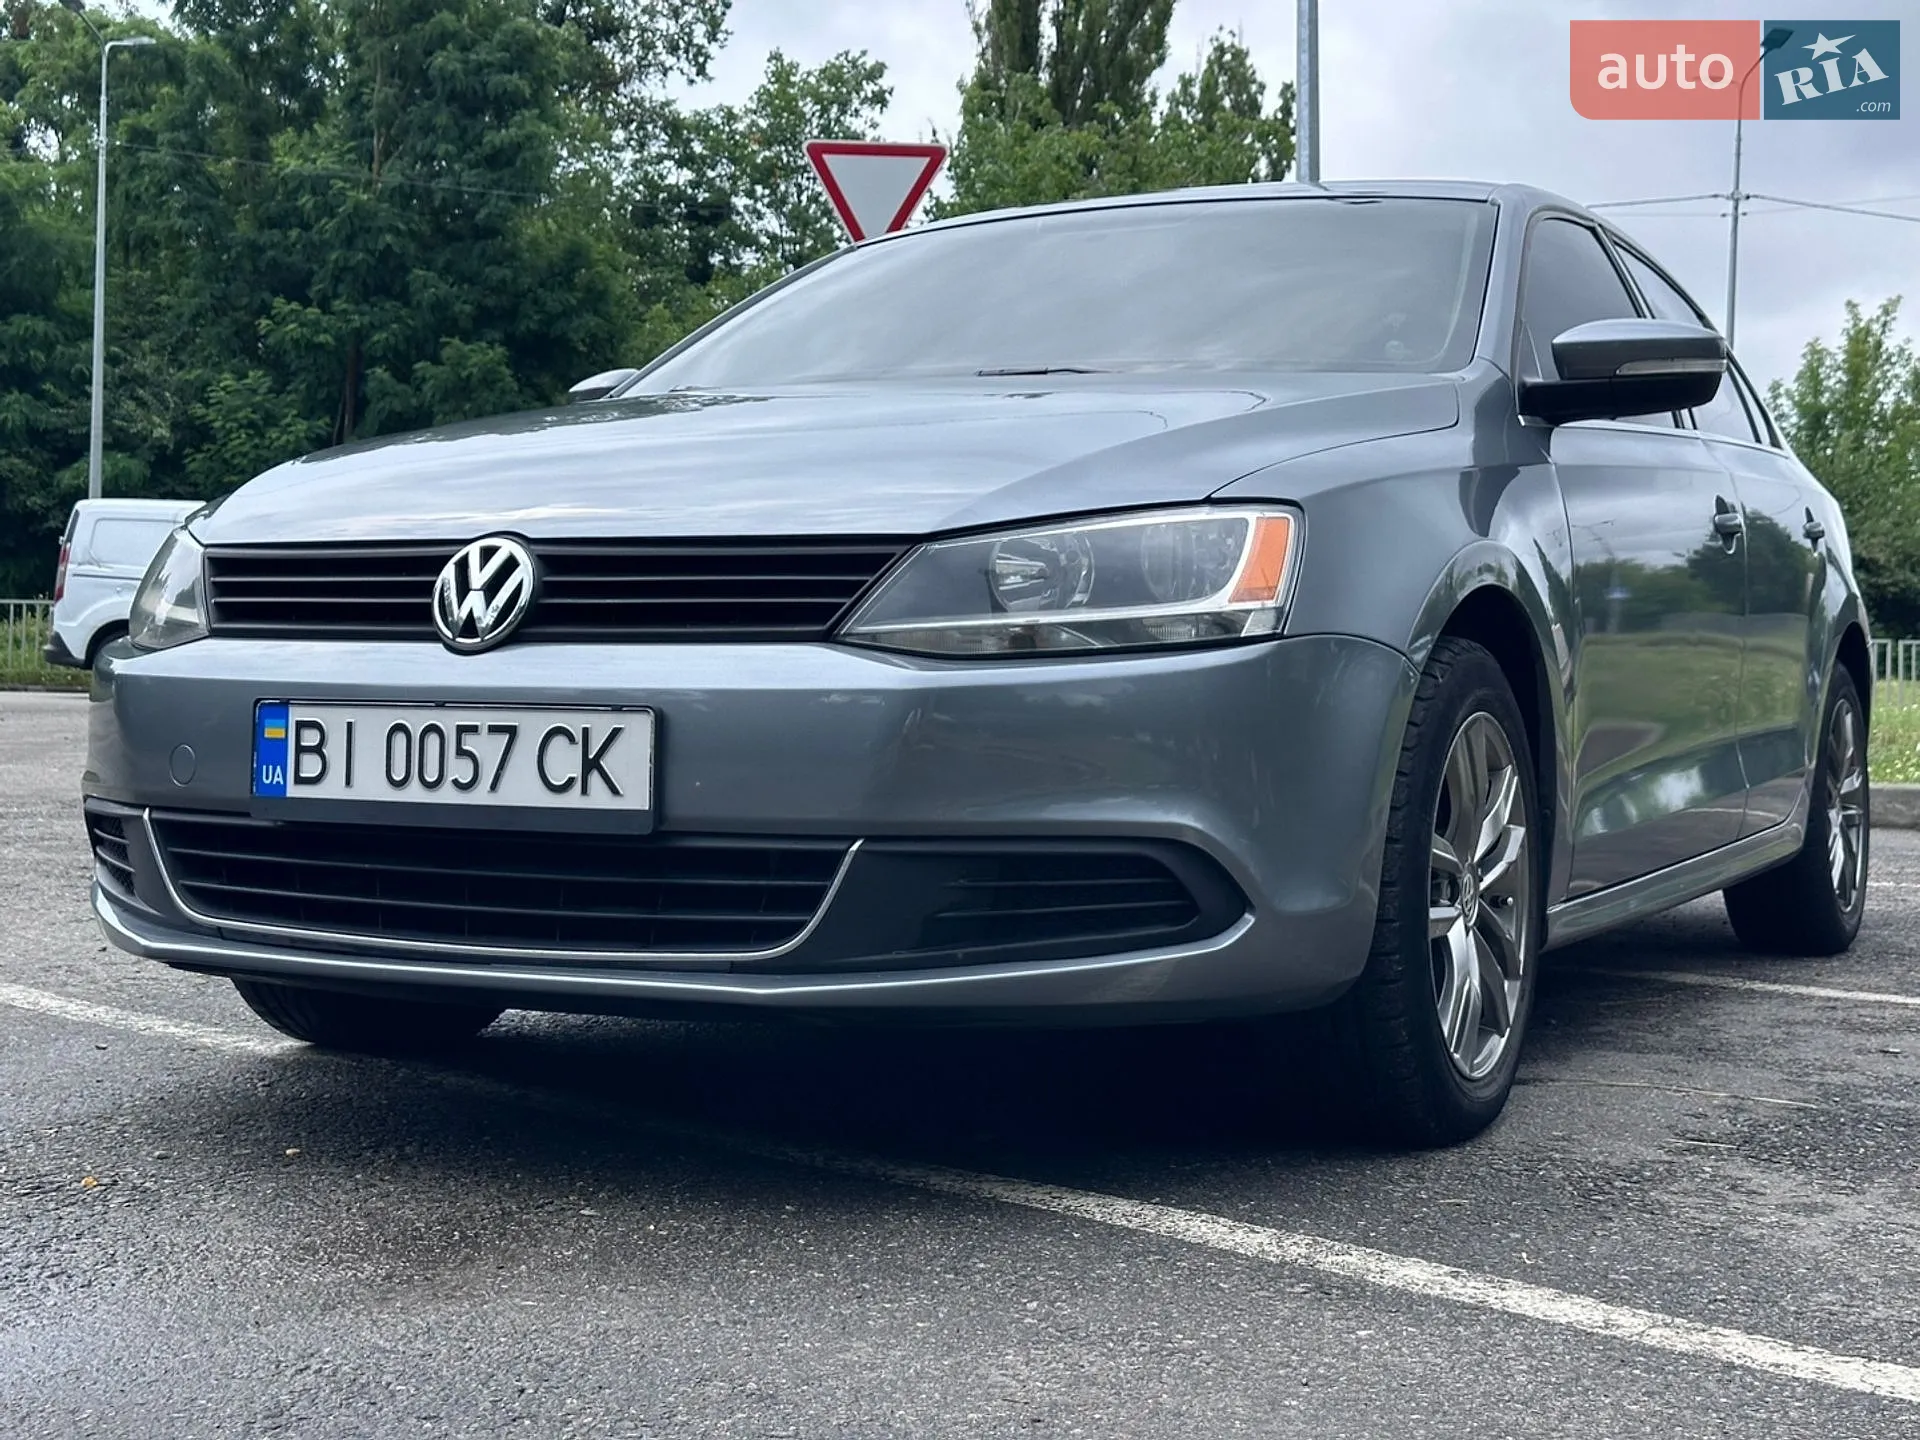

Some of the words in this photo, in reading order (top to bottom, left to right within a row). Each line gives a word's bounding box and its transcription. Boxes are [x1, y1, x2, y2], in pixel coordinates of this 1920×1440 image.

[261, 765, 284, 785] UA
[293, 719, 355, 788] BI
[384, 720, 519, 792] 0057
[537, 723, 625, 796] CK
